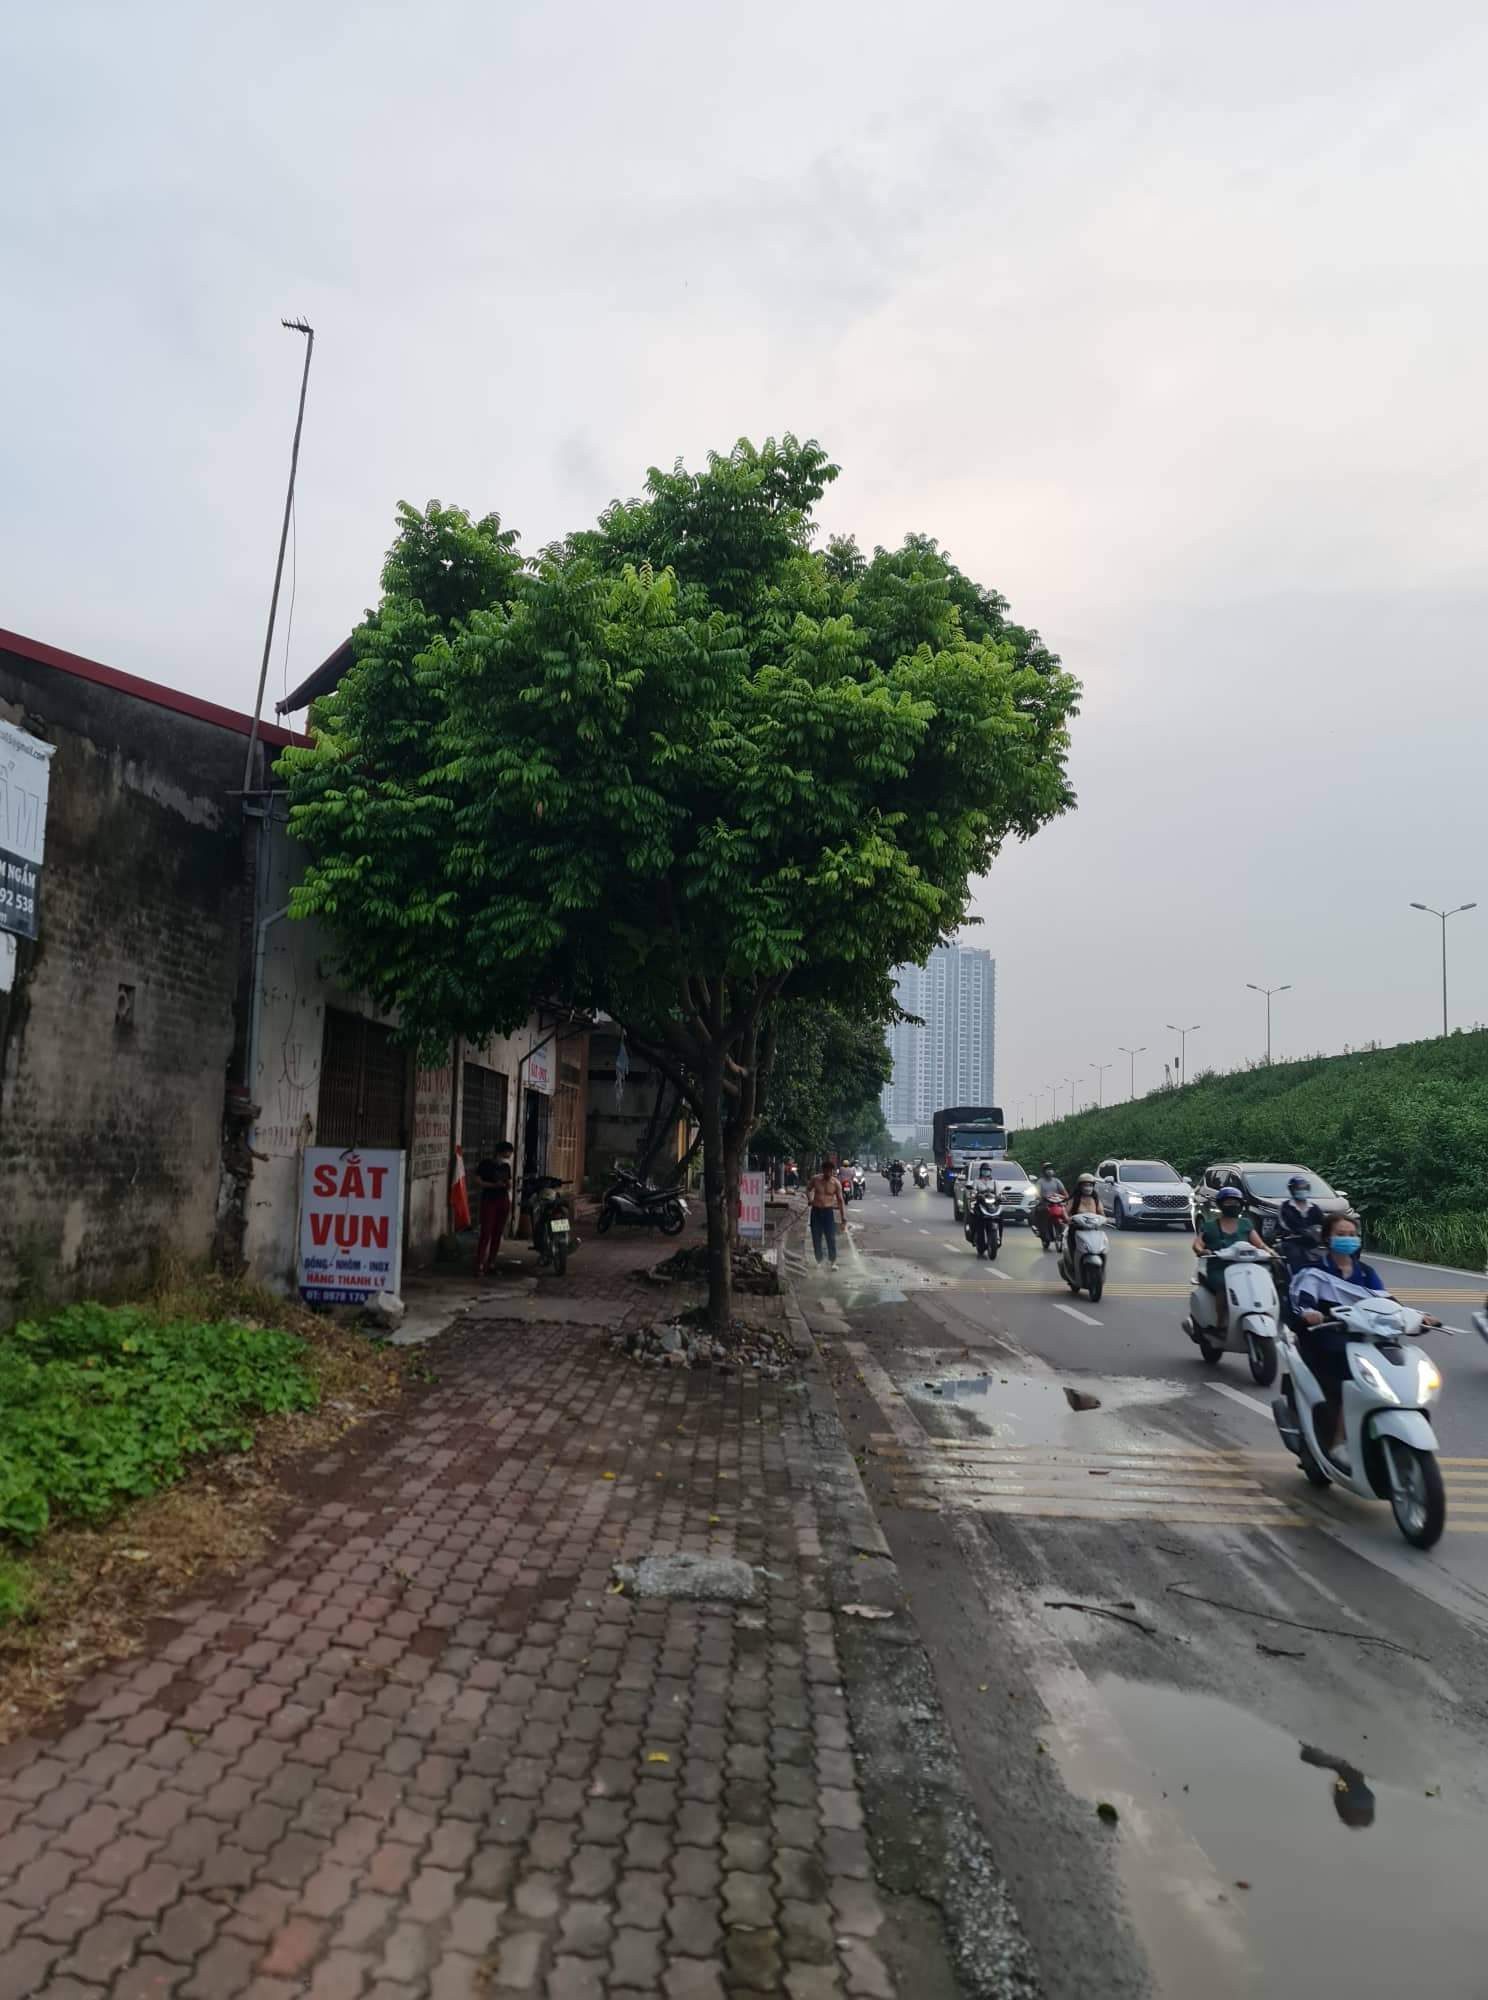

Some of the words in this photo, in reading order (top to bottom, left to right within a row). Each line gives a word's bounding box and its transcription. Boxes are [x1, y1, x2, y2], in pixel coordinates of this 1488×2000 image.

[15, 893, 33, 914] 538
[313, 1154, 389, 1199] SẮT
[310, 1212, 389, 1254] VỤN
[338, 1274, 371, 1286] THANH
